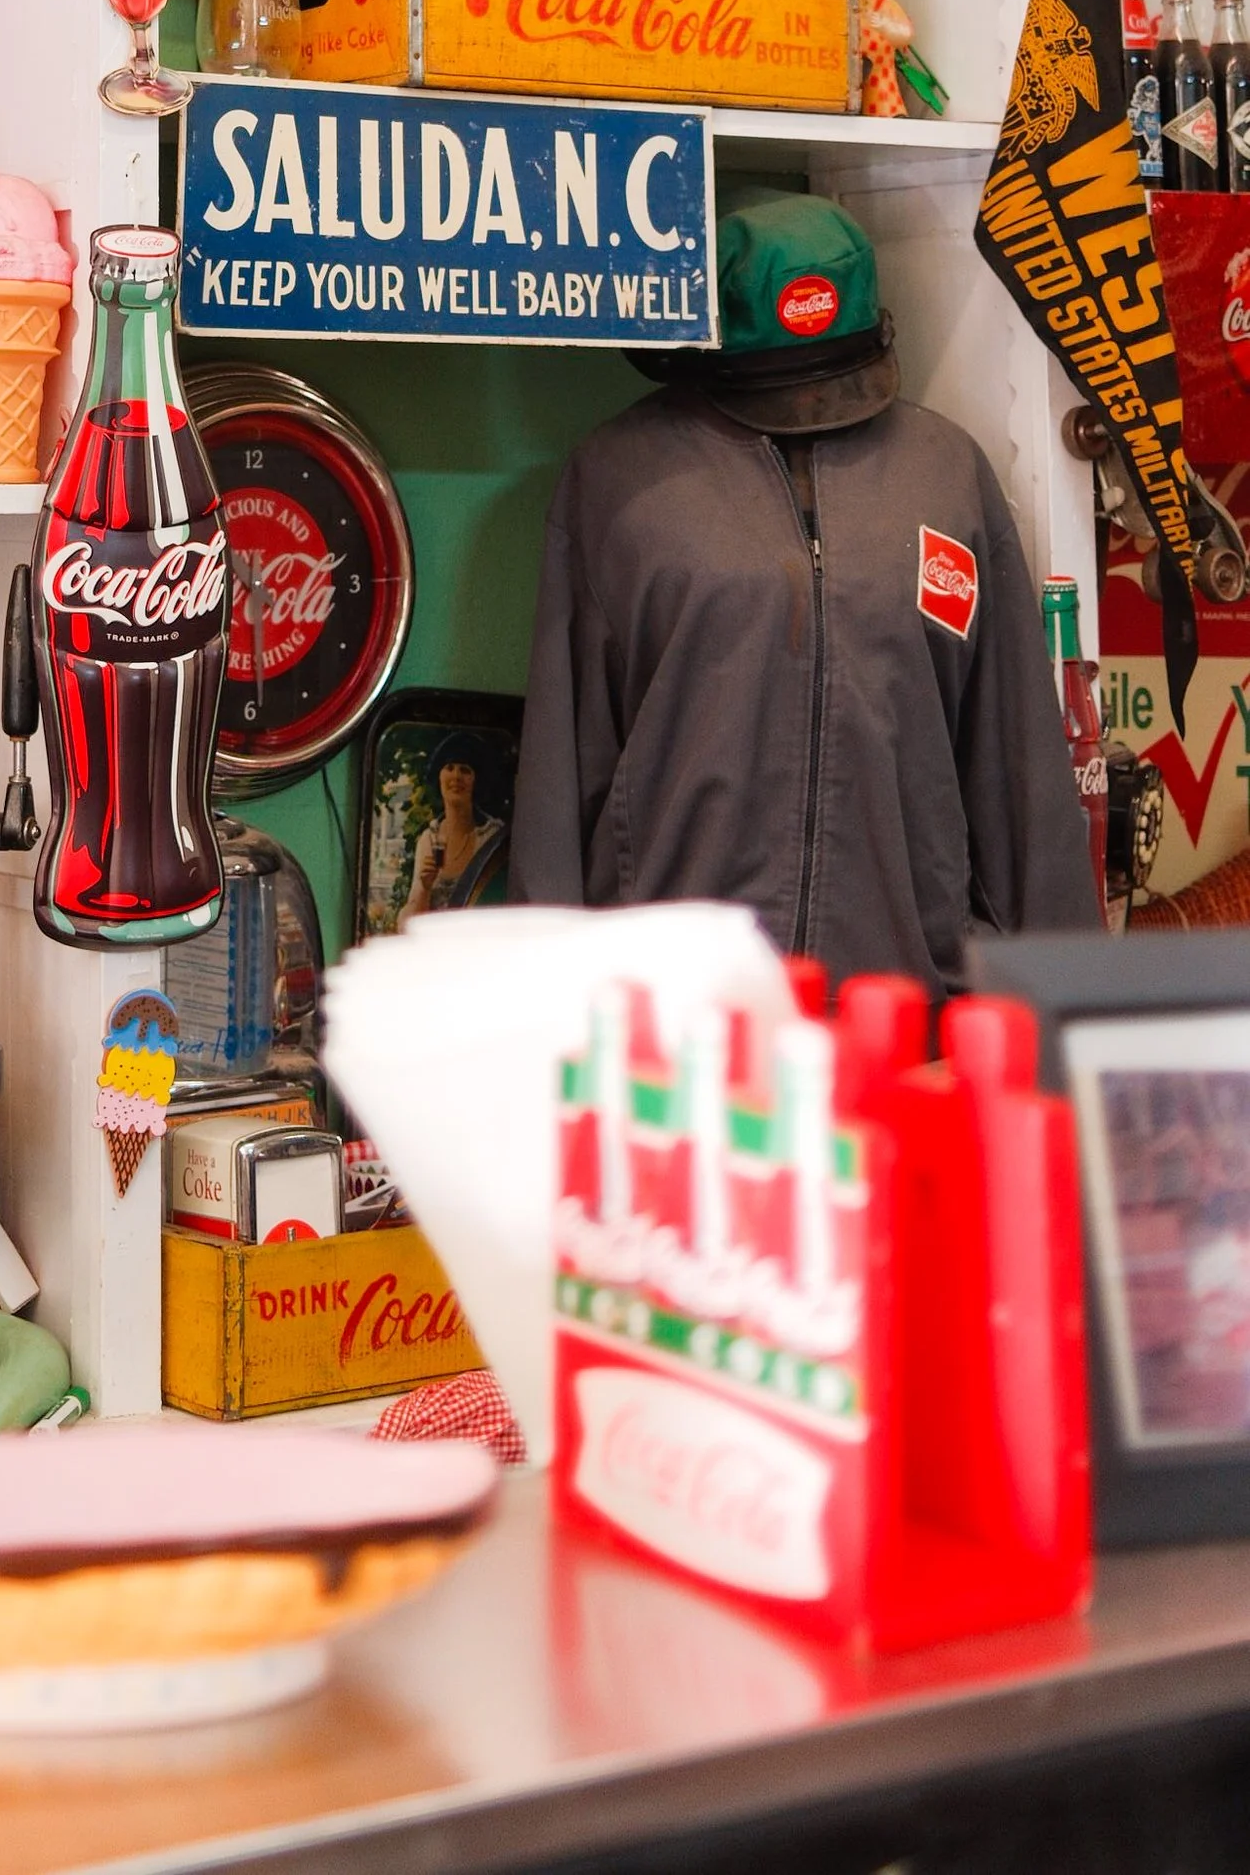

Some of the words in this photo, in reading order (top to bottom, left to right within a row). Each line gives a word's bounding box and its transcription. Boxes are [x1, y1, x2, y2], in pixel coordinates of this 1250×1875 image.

[784, 12, 810, 36] IN
[317, 34, 343, 55] like
[347, 27, 385, 49] Coke
[755, 42, 841, 71] BOTTLES
[203, 108, 543, 252] SALUDA,
[306, 262, 405, 312] YOUR
[417, 265, 507, 316] WELL
[516, 271, 604, 319] BABY
[783, 291, 835, 319] Coca-Cola
[980, 158, 1084, 300] UNITED
[1046, 293, 1148, 424] STATES
[1123, 420, 1192, 555] MILITARY
[244, 450, 264, 469] 12
[277, 507, 311, 543] AND
[42, 529, 227, 627] Coca-Cola
[349, 575, 361, 594] 3
[924, 556, 976, 602] Coca-Cola
[244, 701, 257, 721] 6
[187, 1148, 209, 1169] Have
[210, 1157, 216, 1169] a
[182, 1166, 223, 1202] Coke
[257, 1279, 351, 1322] DRINK
